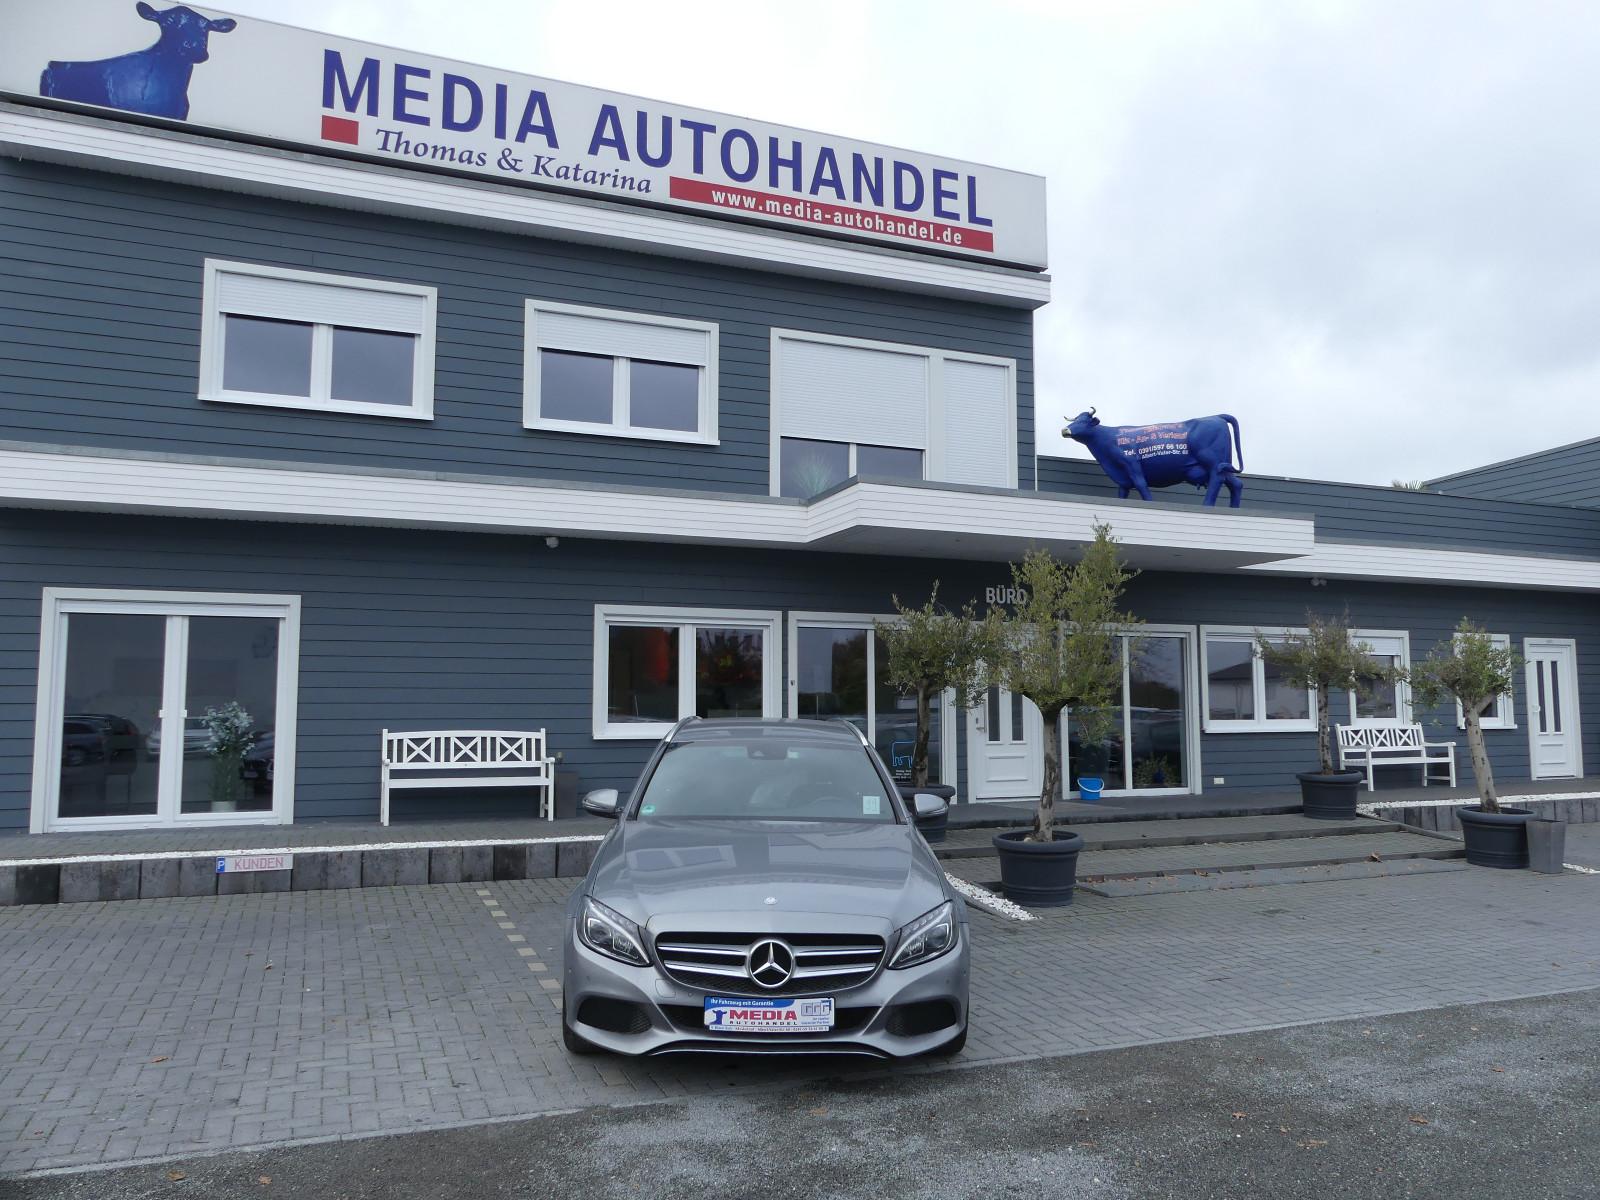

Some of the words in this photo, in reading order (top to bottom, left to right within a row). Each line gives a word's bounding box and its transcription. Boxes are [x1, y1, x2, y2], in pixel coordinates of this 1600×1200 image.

[322, 48, 560, 150] MEDIA
[587, 103, 993, 228] AUTOHANDEL
[376, 128, 487, 167] Thomas
[496, 147, 524, 173] &
[530, 154, 652, 194] Katarina
[711, 189, 963, 245] www.media-autohandel.de
[985, 584, 1027, 605] BÜRO
[217, 860, 225, 870] P
[234, 857, 284, 871] KUNDEN
[729, 1009, 798, 1021] MEDIA
